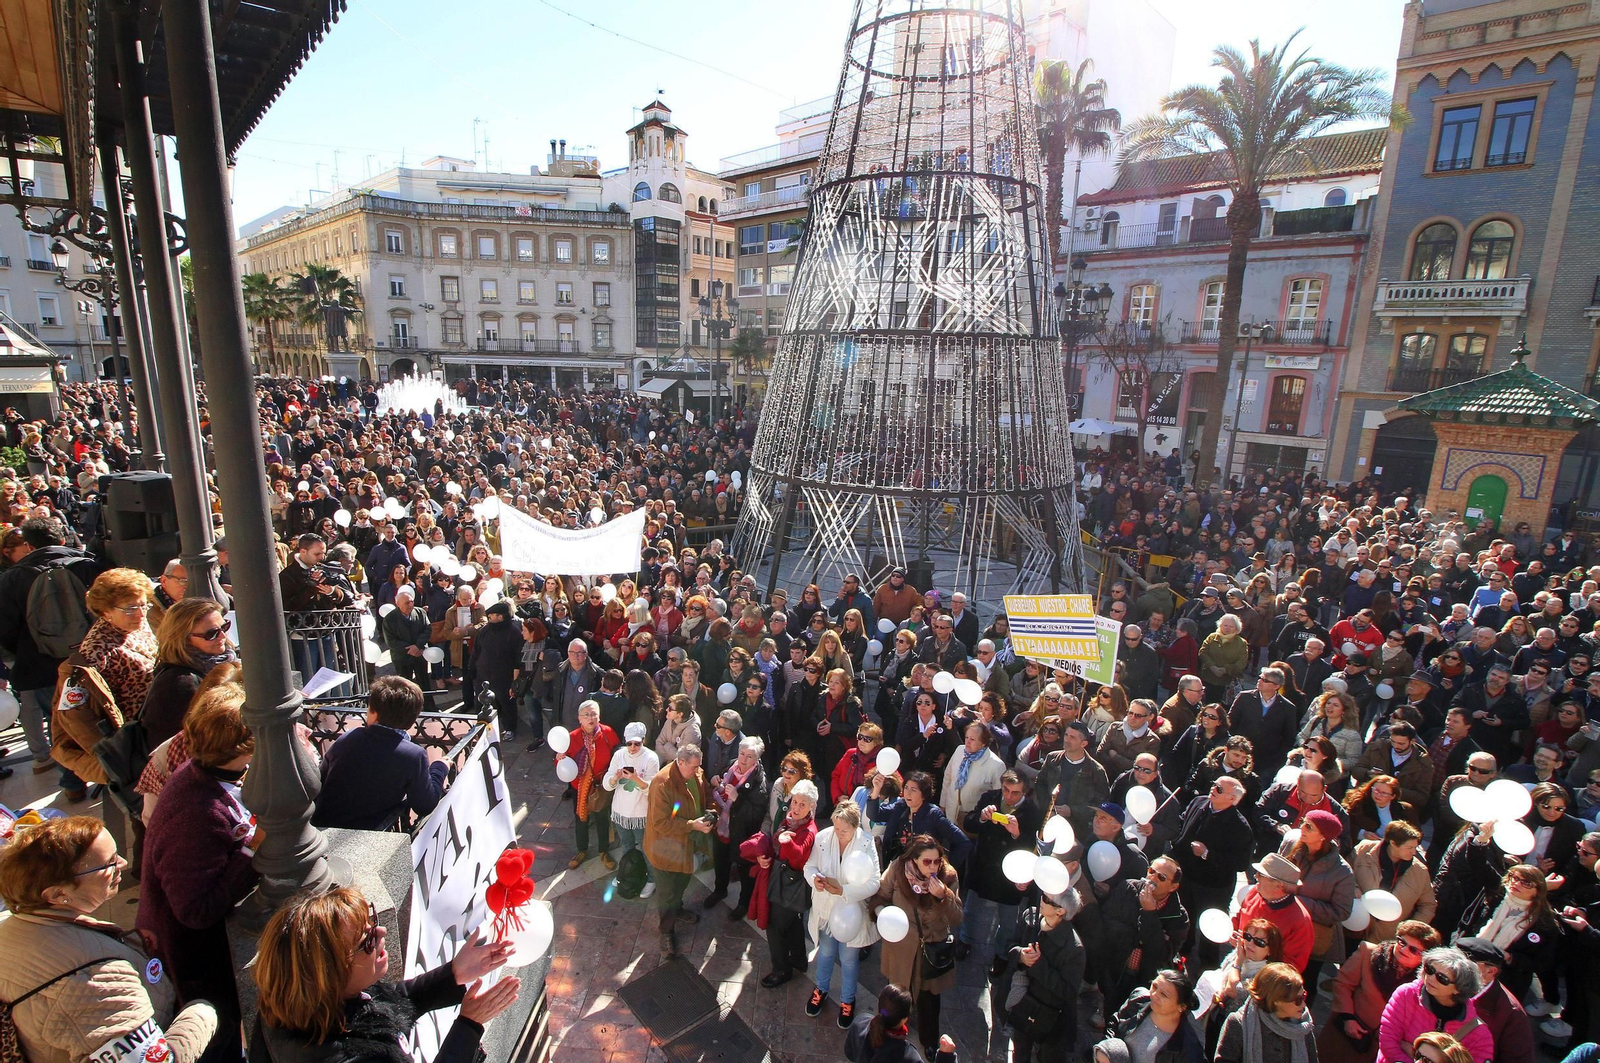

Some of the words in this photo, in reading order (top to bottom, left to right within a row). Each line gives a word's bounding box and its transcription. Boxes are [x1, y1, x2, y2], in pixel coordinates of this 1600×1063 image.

[2, 384, 32, 392] FERNANDO
[1007, 598, 1038, 613] QUEREMOS
[1038, 598, 1068, 613] NUESTRO
[1069, 598, 1091, 614] CHARE
[1097, 633, 1110, 644] TAL
[1054, 659, 1082, 675] MEDIOS
[414, 804, 472, 911] VA,
[478, 741, 505, 817] P
[91, 1018, 158, 1063] GANIZ
